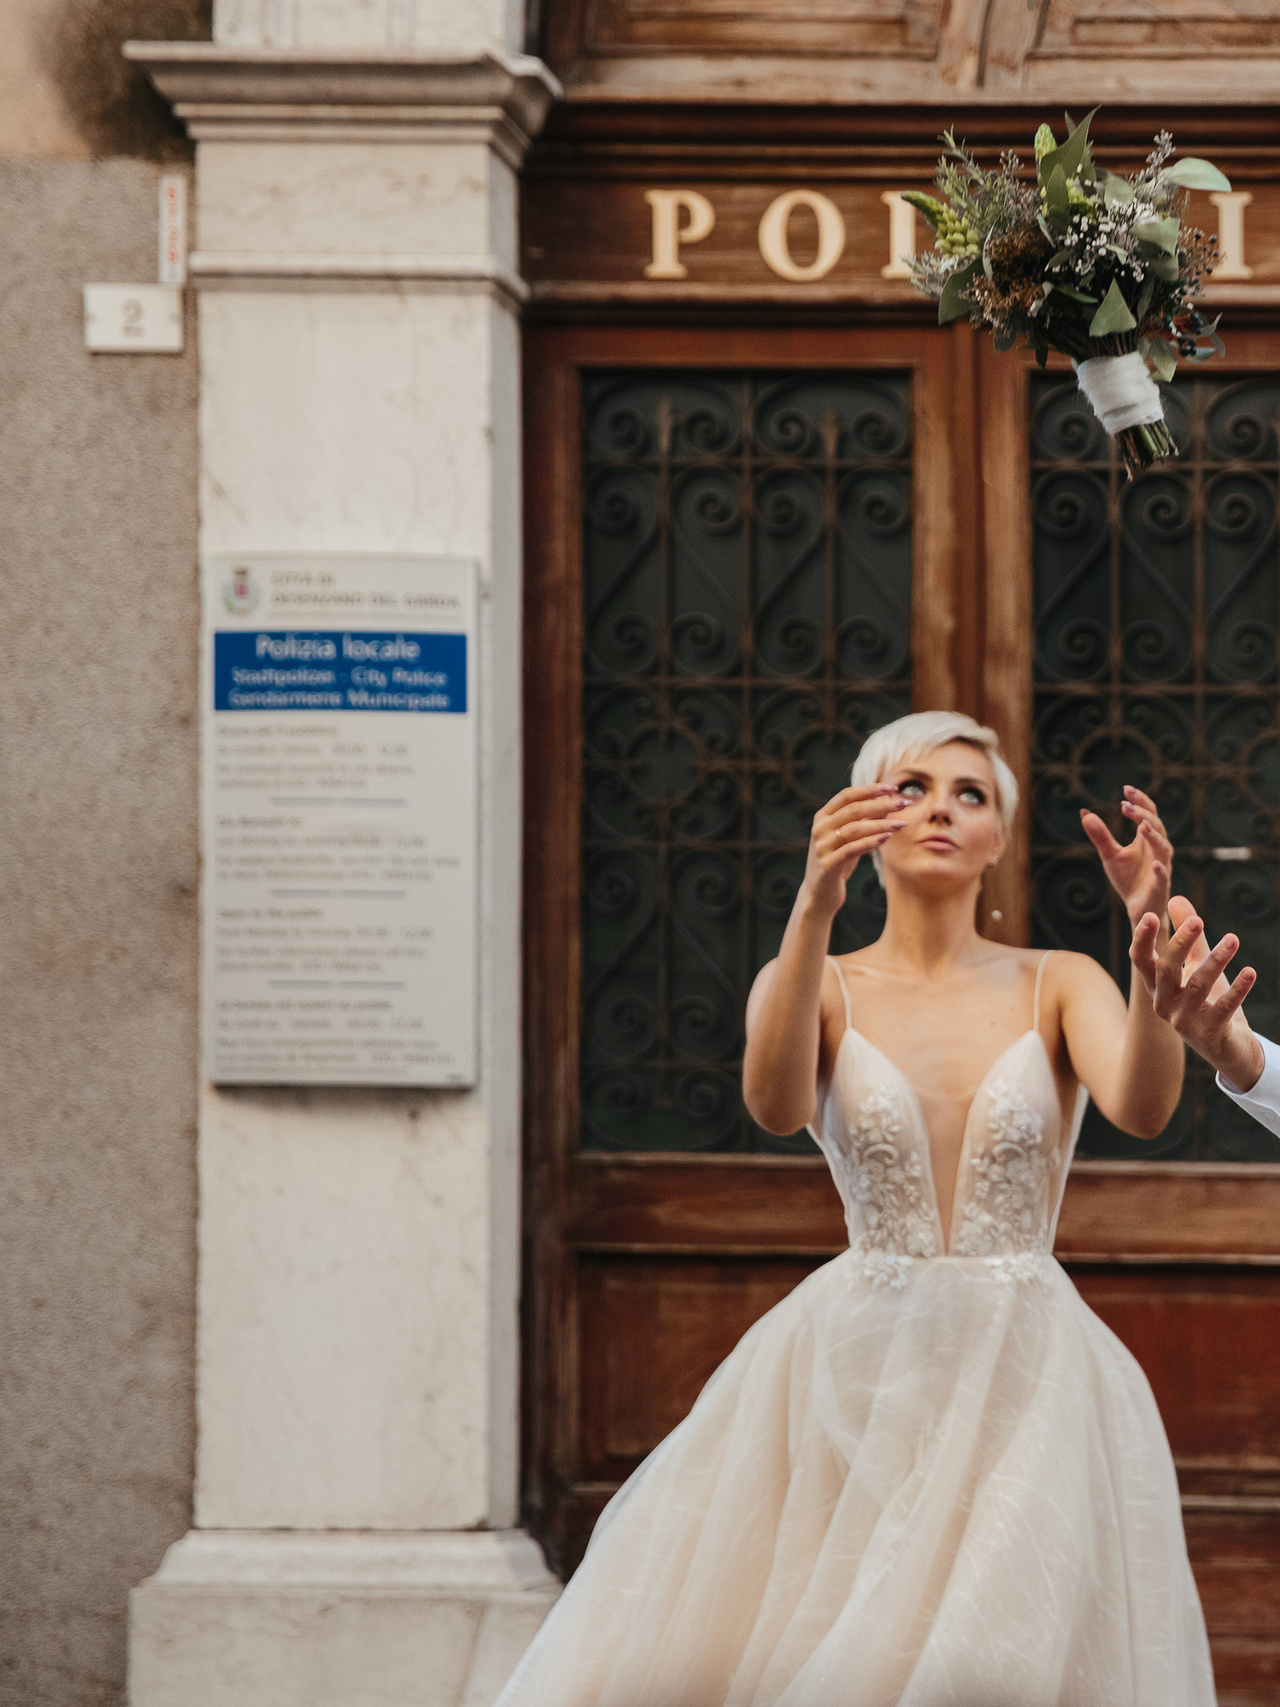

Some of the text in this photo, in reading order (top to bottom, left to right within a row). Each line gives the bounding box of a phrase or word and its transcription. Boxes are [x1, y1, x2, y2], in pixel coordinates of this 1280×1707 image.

[121, 298, 144, 338] 2
[255, 632, 421, 662] Polizia locale
